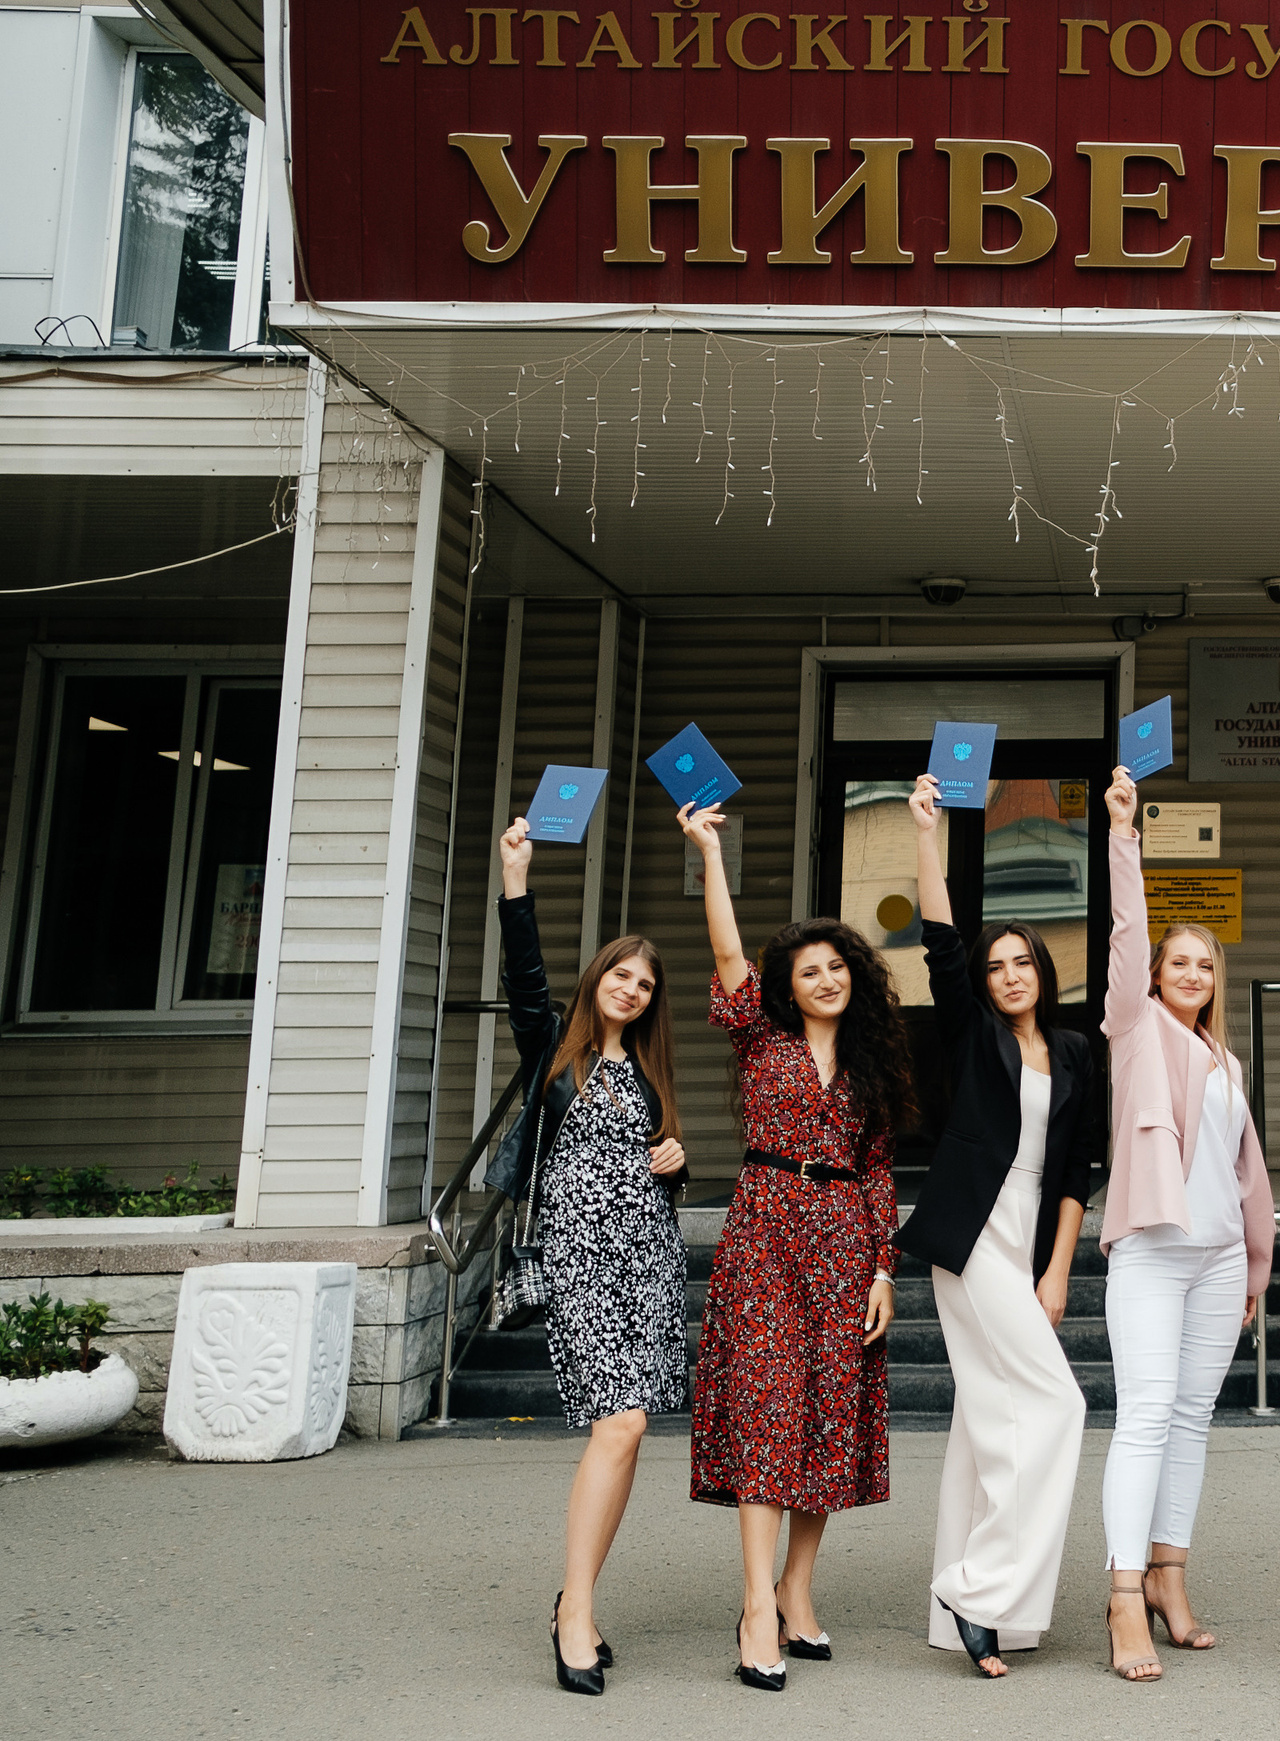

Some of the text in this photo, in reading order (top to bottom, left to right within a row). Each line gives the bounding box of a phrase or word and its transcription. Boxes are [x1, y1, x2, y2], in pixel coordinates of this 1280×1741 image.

[380, 0, 1010, 73] АЛТАЙСКИЙ
[939, 780, 974, 788] ДИПЛОМ
[538, 816, 573, 824] ДИПЛОМ
